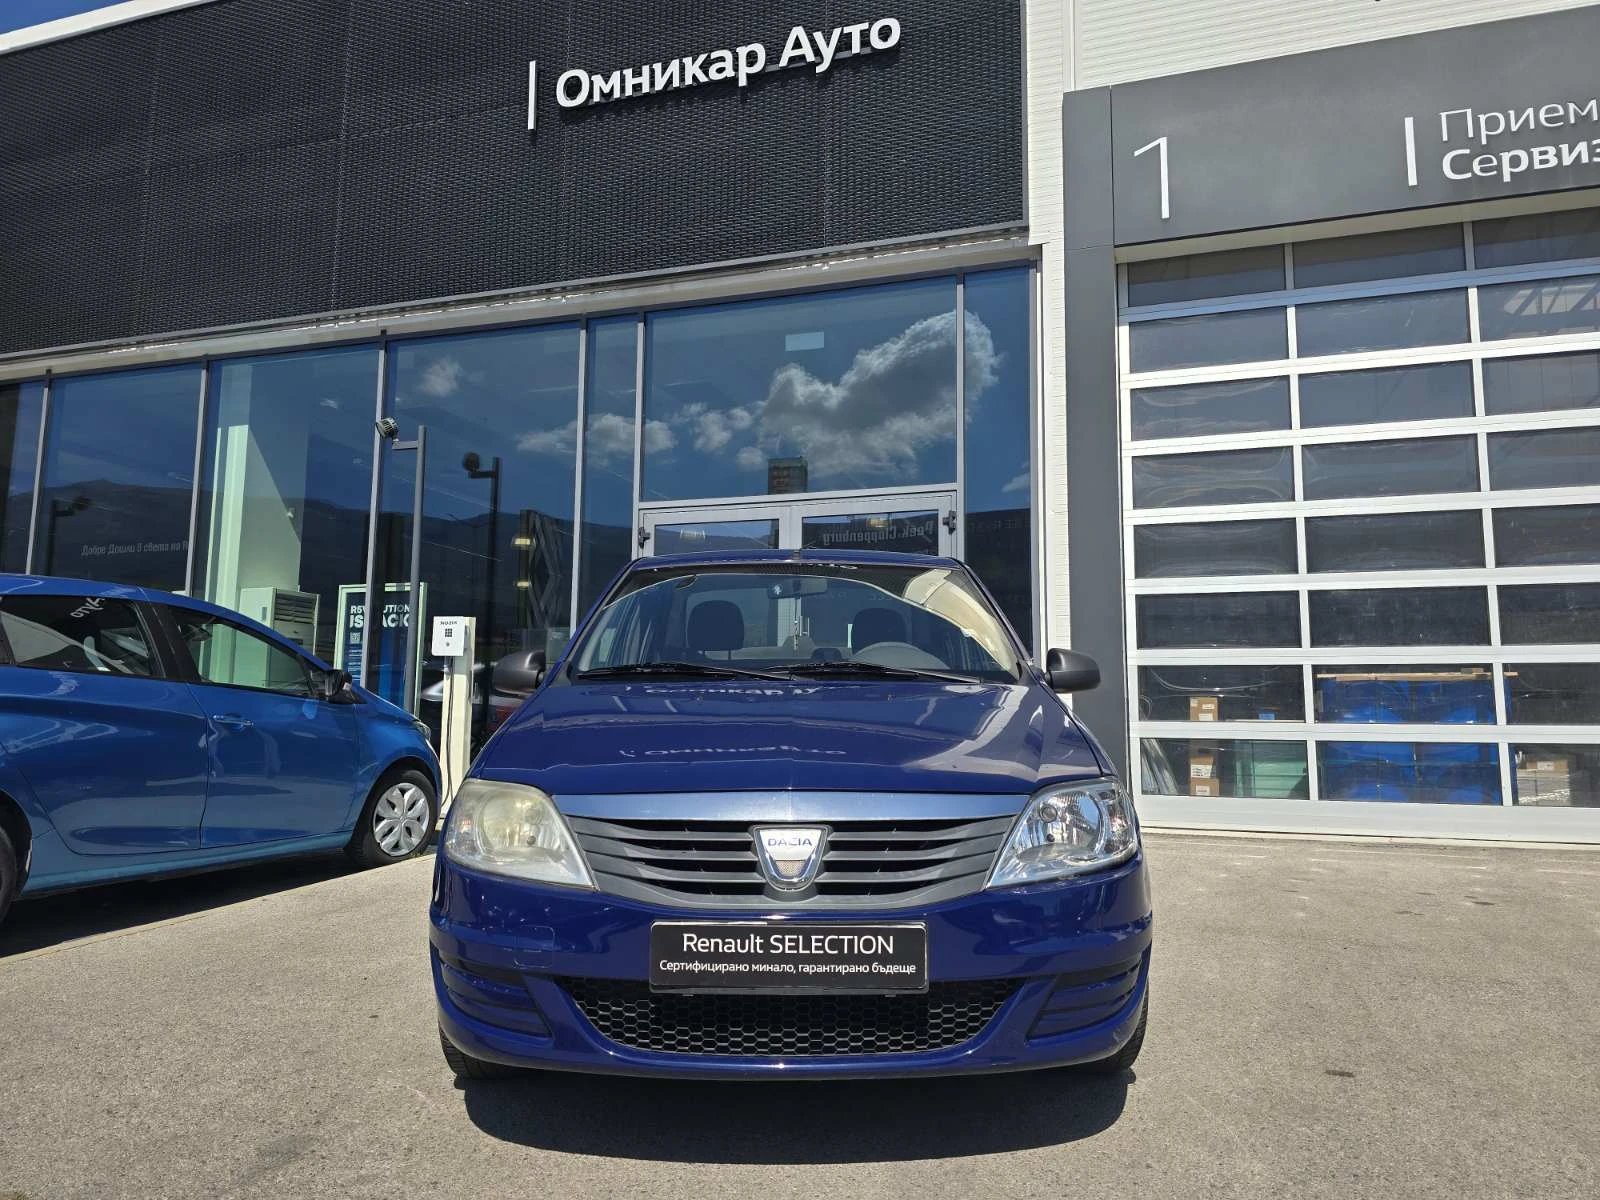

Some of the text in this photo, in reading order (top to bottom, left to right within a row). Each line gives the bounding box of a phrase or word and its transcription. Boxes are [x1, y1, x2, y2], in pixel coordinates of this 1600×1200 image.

[555, 17, 902, 108] Омникар Ауто
[1439, 98, 1600, 145] Прием
[1133, 136, 1171, 219] 1
[767, 838, 813, 847] DACIA
[683, 933, 894, 955] Renault SELECTION
[659, 959, 917, 975] Сертифицирано минало, гарантирано бъдеще
